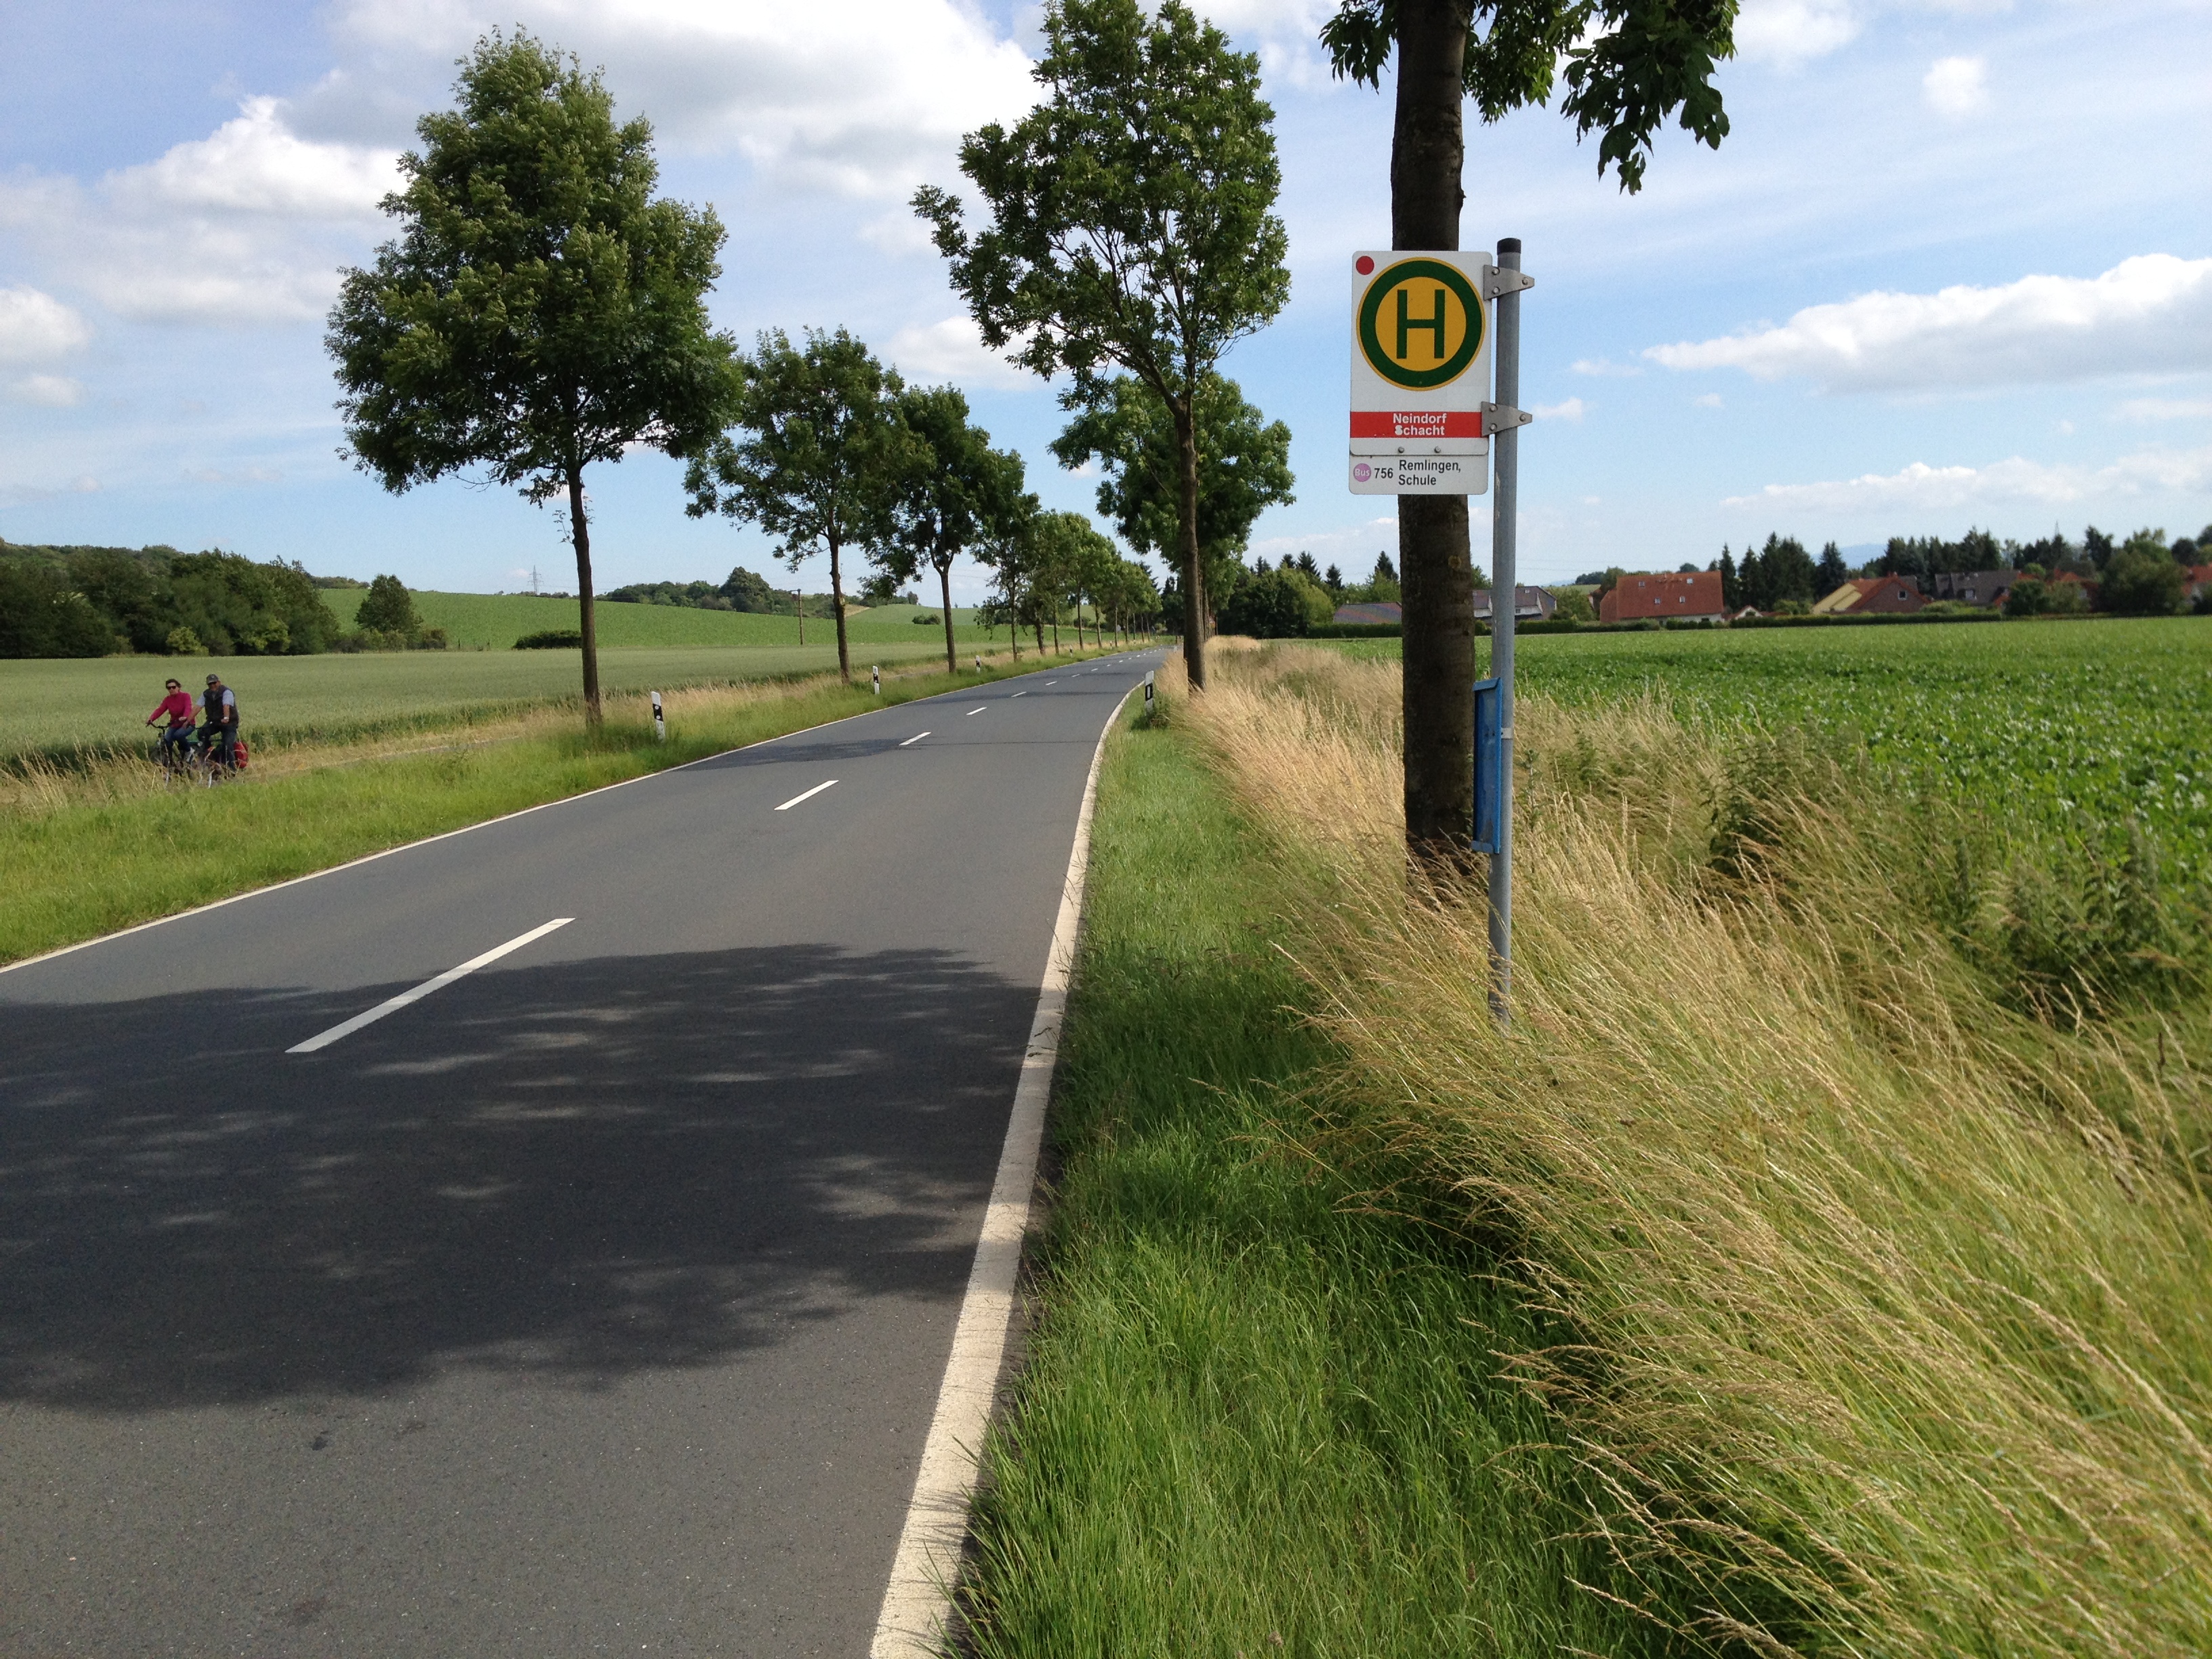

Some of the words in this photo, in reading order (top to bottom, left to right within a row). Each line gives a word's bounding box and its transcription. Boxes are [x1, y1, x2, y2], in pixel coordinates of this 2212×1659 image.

[1393, 413, 1448, 424] Neindorf
[1395, 425, 1445, 436] Schacht
[1399, 459, 1461, 474] Remlingen,
[1355, 468, 1370, 477] Bus
[1374, 468, 1393, 479] 756
[1398, 474, 1437, 485] Schule
